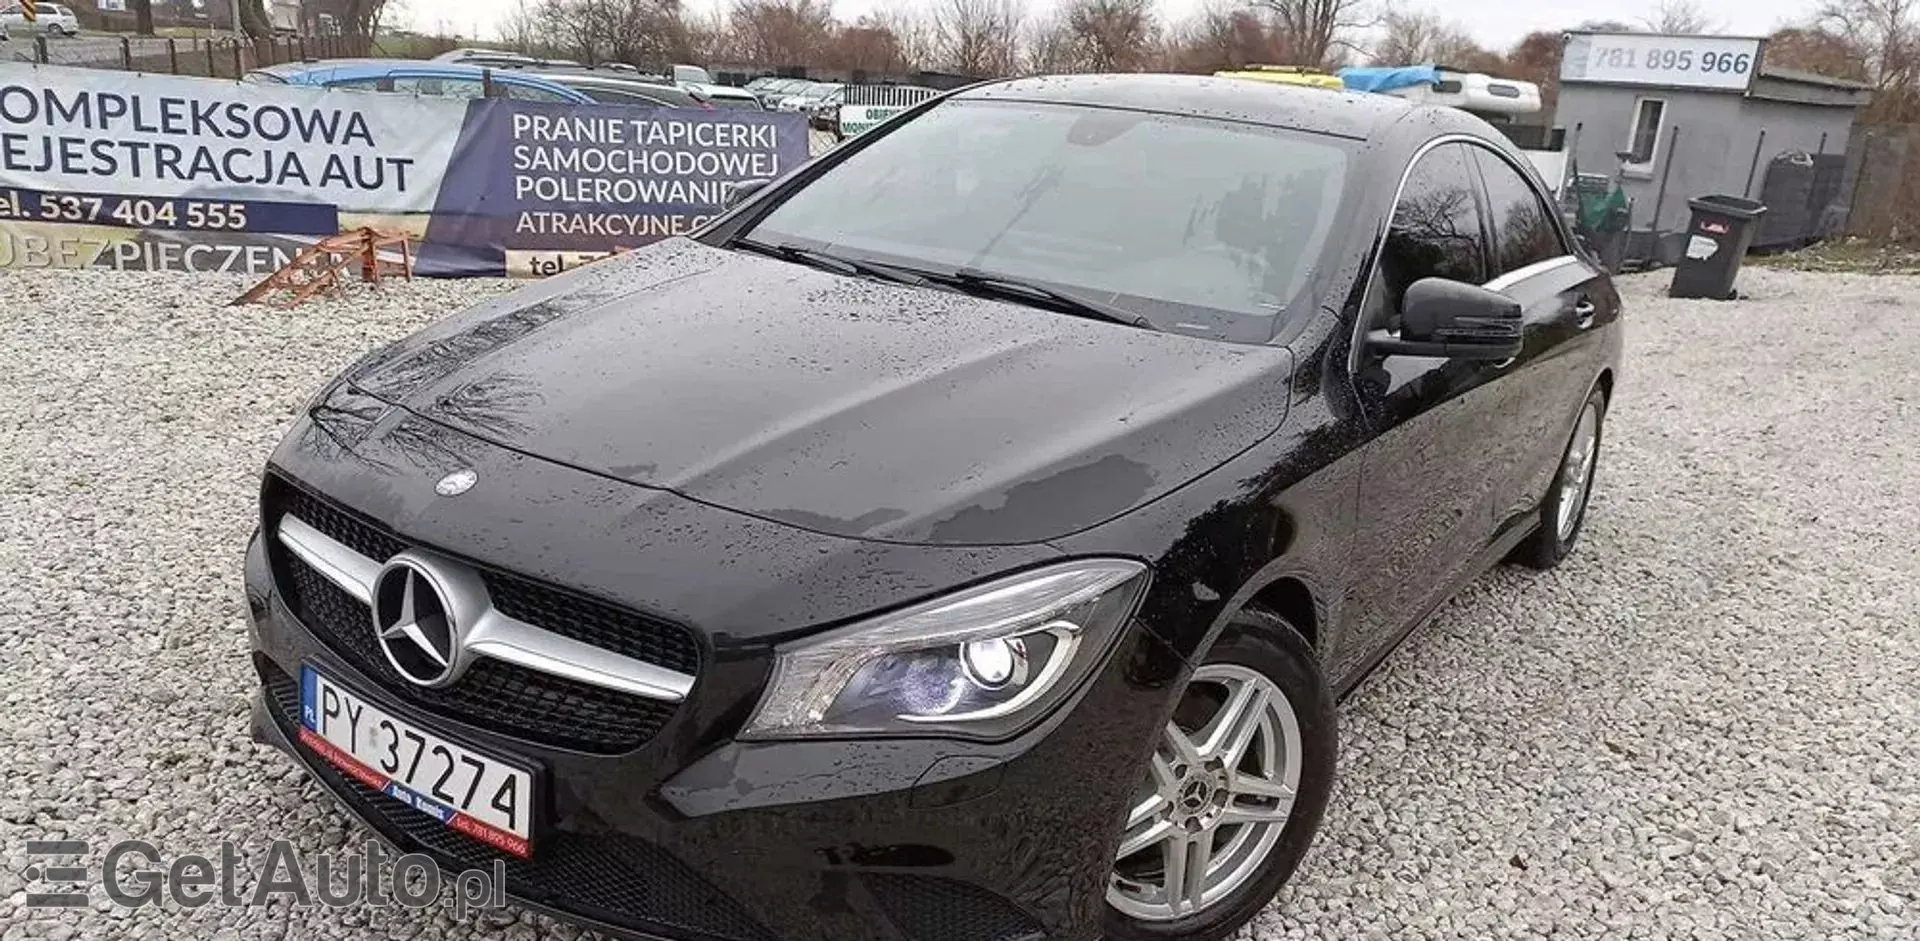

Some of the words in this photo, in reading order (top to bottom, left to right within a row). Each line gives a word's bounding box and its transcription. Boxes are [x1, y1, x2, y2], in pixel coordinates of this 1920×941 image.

[1595, 48, 1638, 69] 781
[1645, 48, 1694, 71] 895
[1700, 51, 1750, 74] 966
[513, 114, 623, 144] PRANIE
[630, 120, 778, 148] TAPICERKI
[2, 133, 311, 187] EJESTRACJA
[319, 151, 414, 192] AUT
[513, 145, 778, 176] SAMOCHODOWEJ
[40, 196, 100, 220] 537
[113, 200, 177, 226] 404
[187, 203, 247, 229] 555
[515, 211, 685, 236] ATRAKCYJNE
[304, 704, 316, 724] PL
[323, 683, 363, 754] PY
[380, 719, 517, 830] 37274
